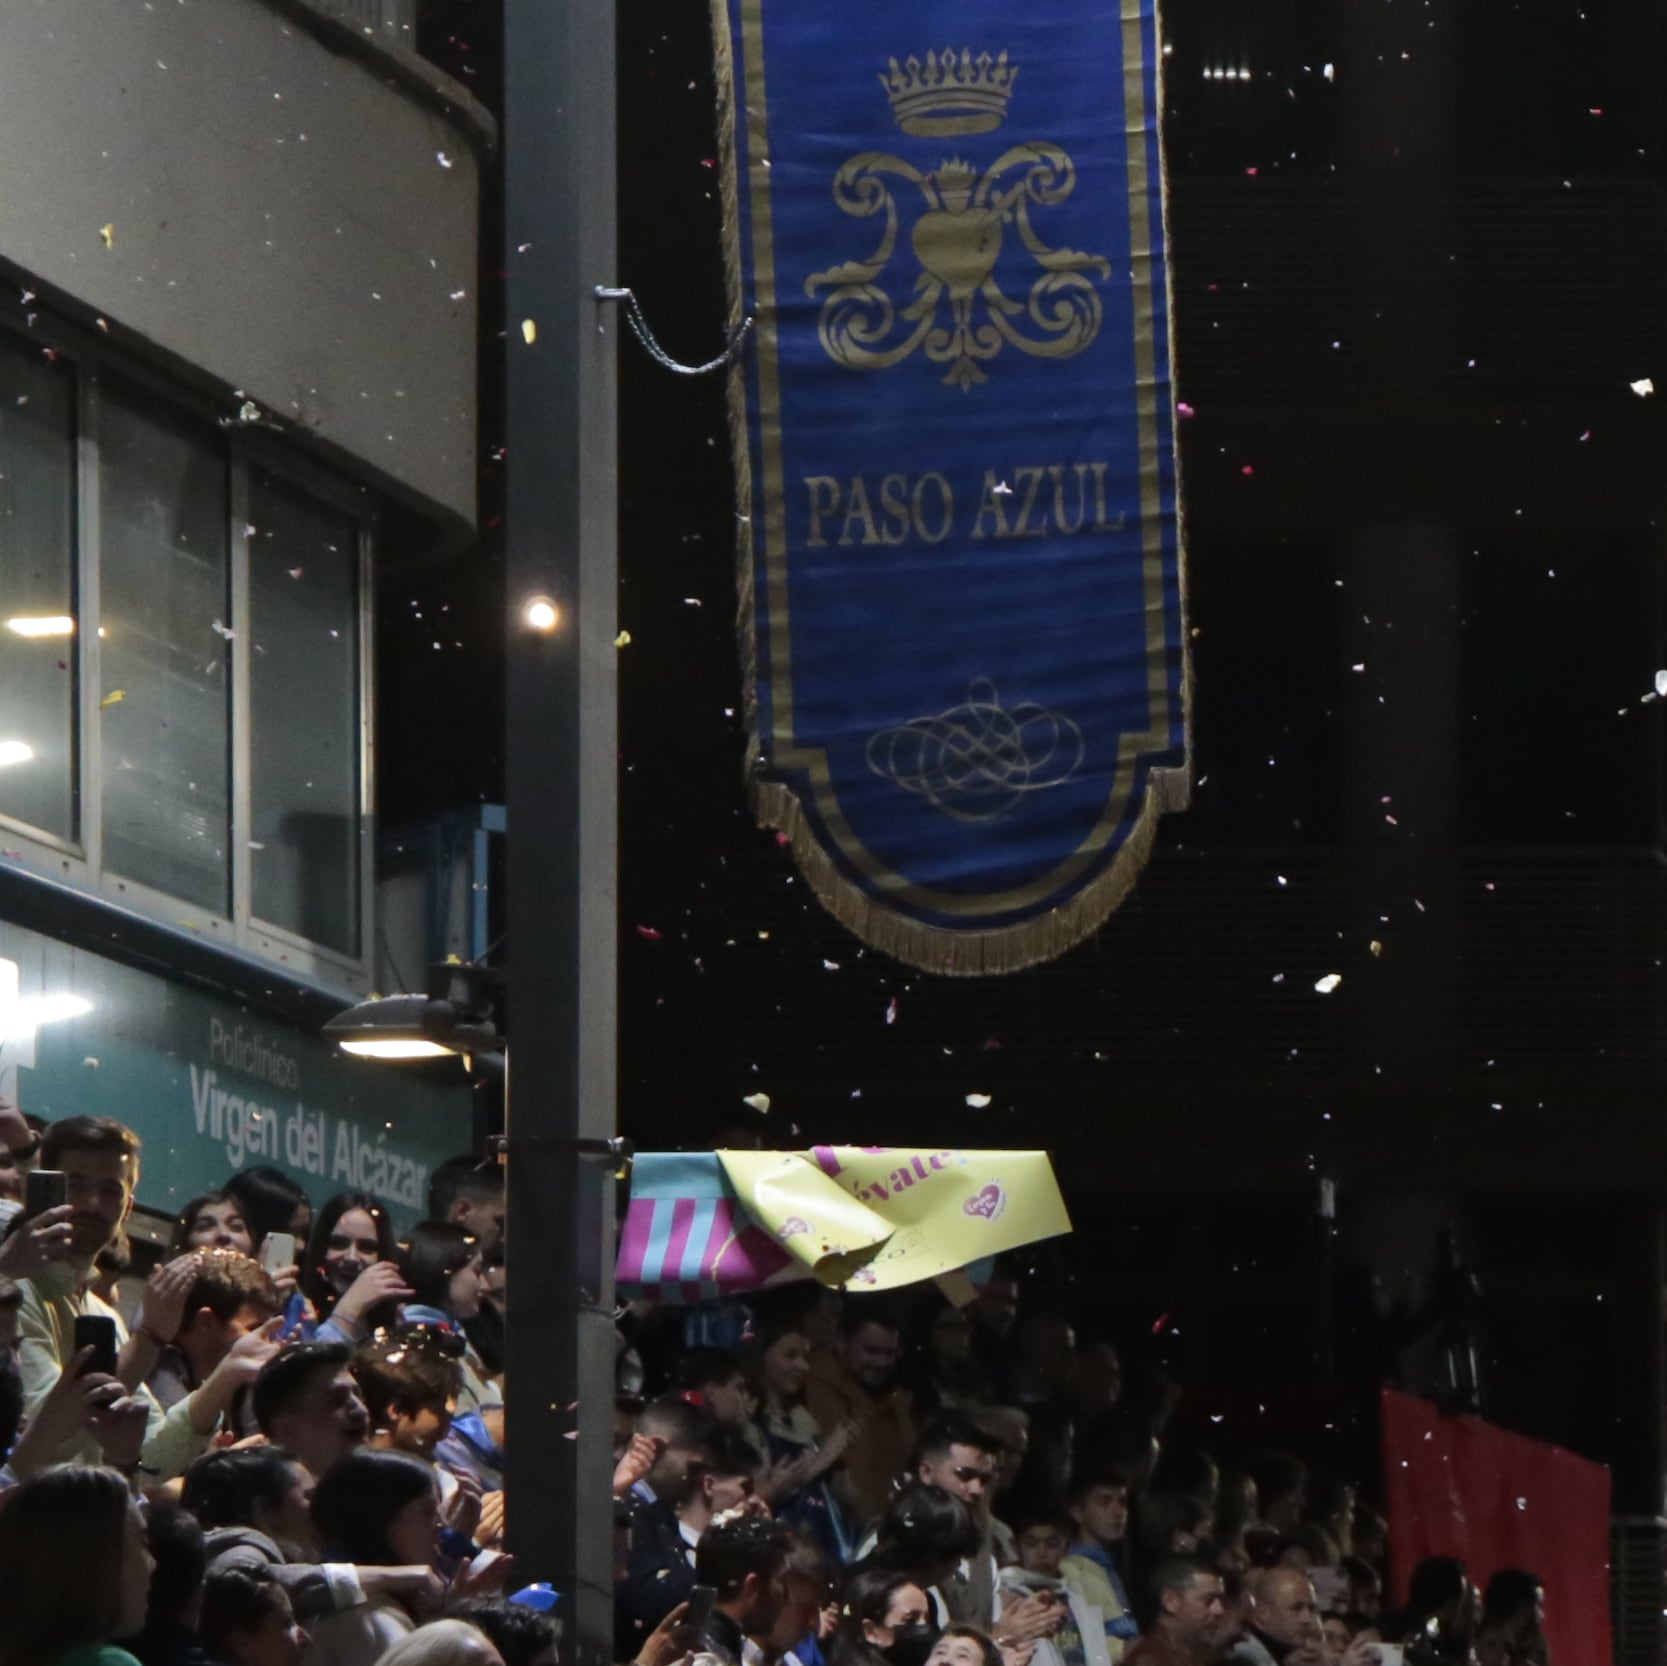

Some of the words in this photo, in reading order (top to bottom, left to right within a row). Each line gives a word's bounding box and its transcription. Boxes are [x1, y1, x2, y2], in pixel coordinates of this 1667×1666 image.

[804, 472, 955, 546] PASO
[971, 463, 1126, 539] AZUL
[191, 1065, 278, 1167] Virgen
[286, 1102, 325, 1175] del
[333, 1120, 428, 1208] Alcázar
